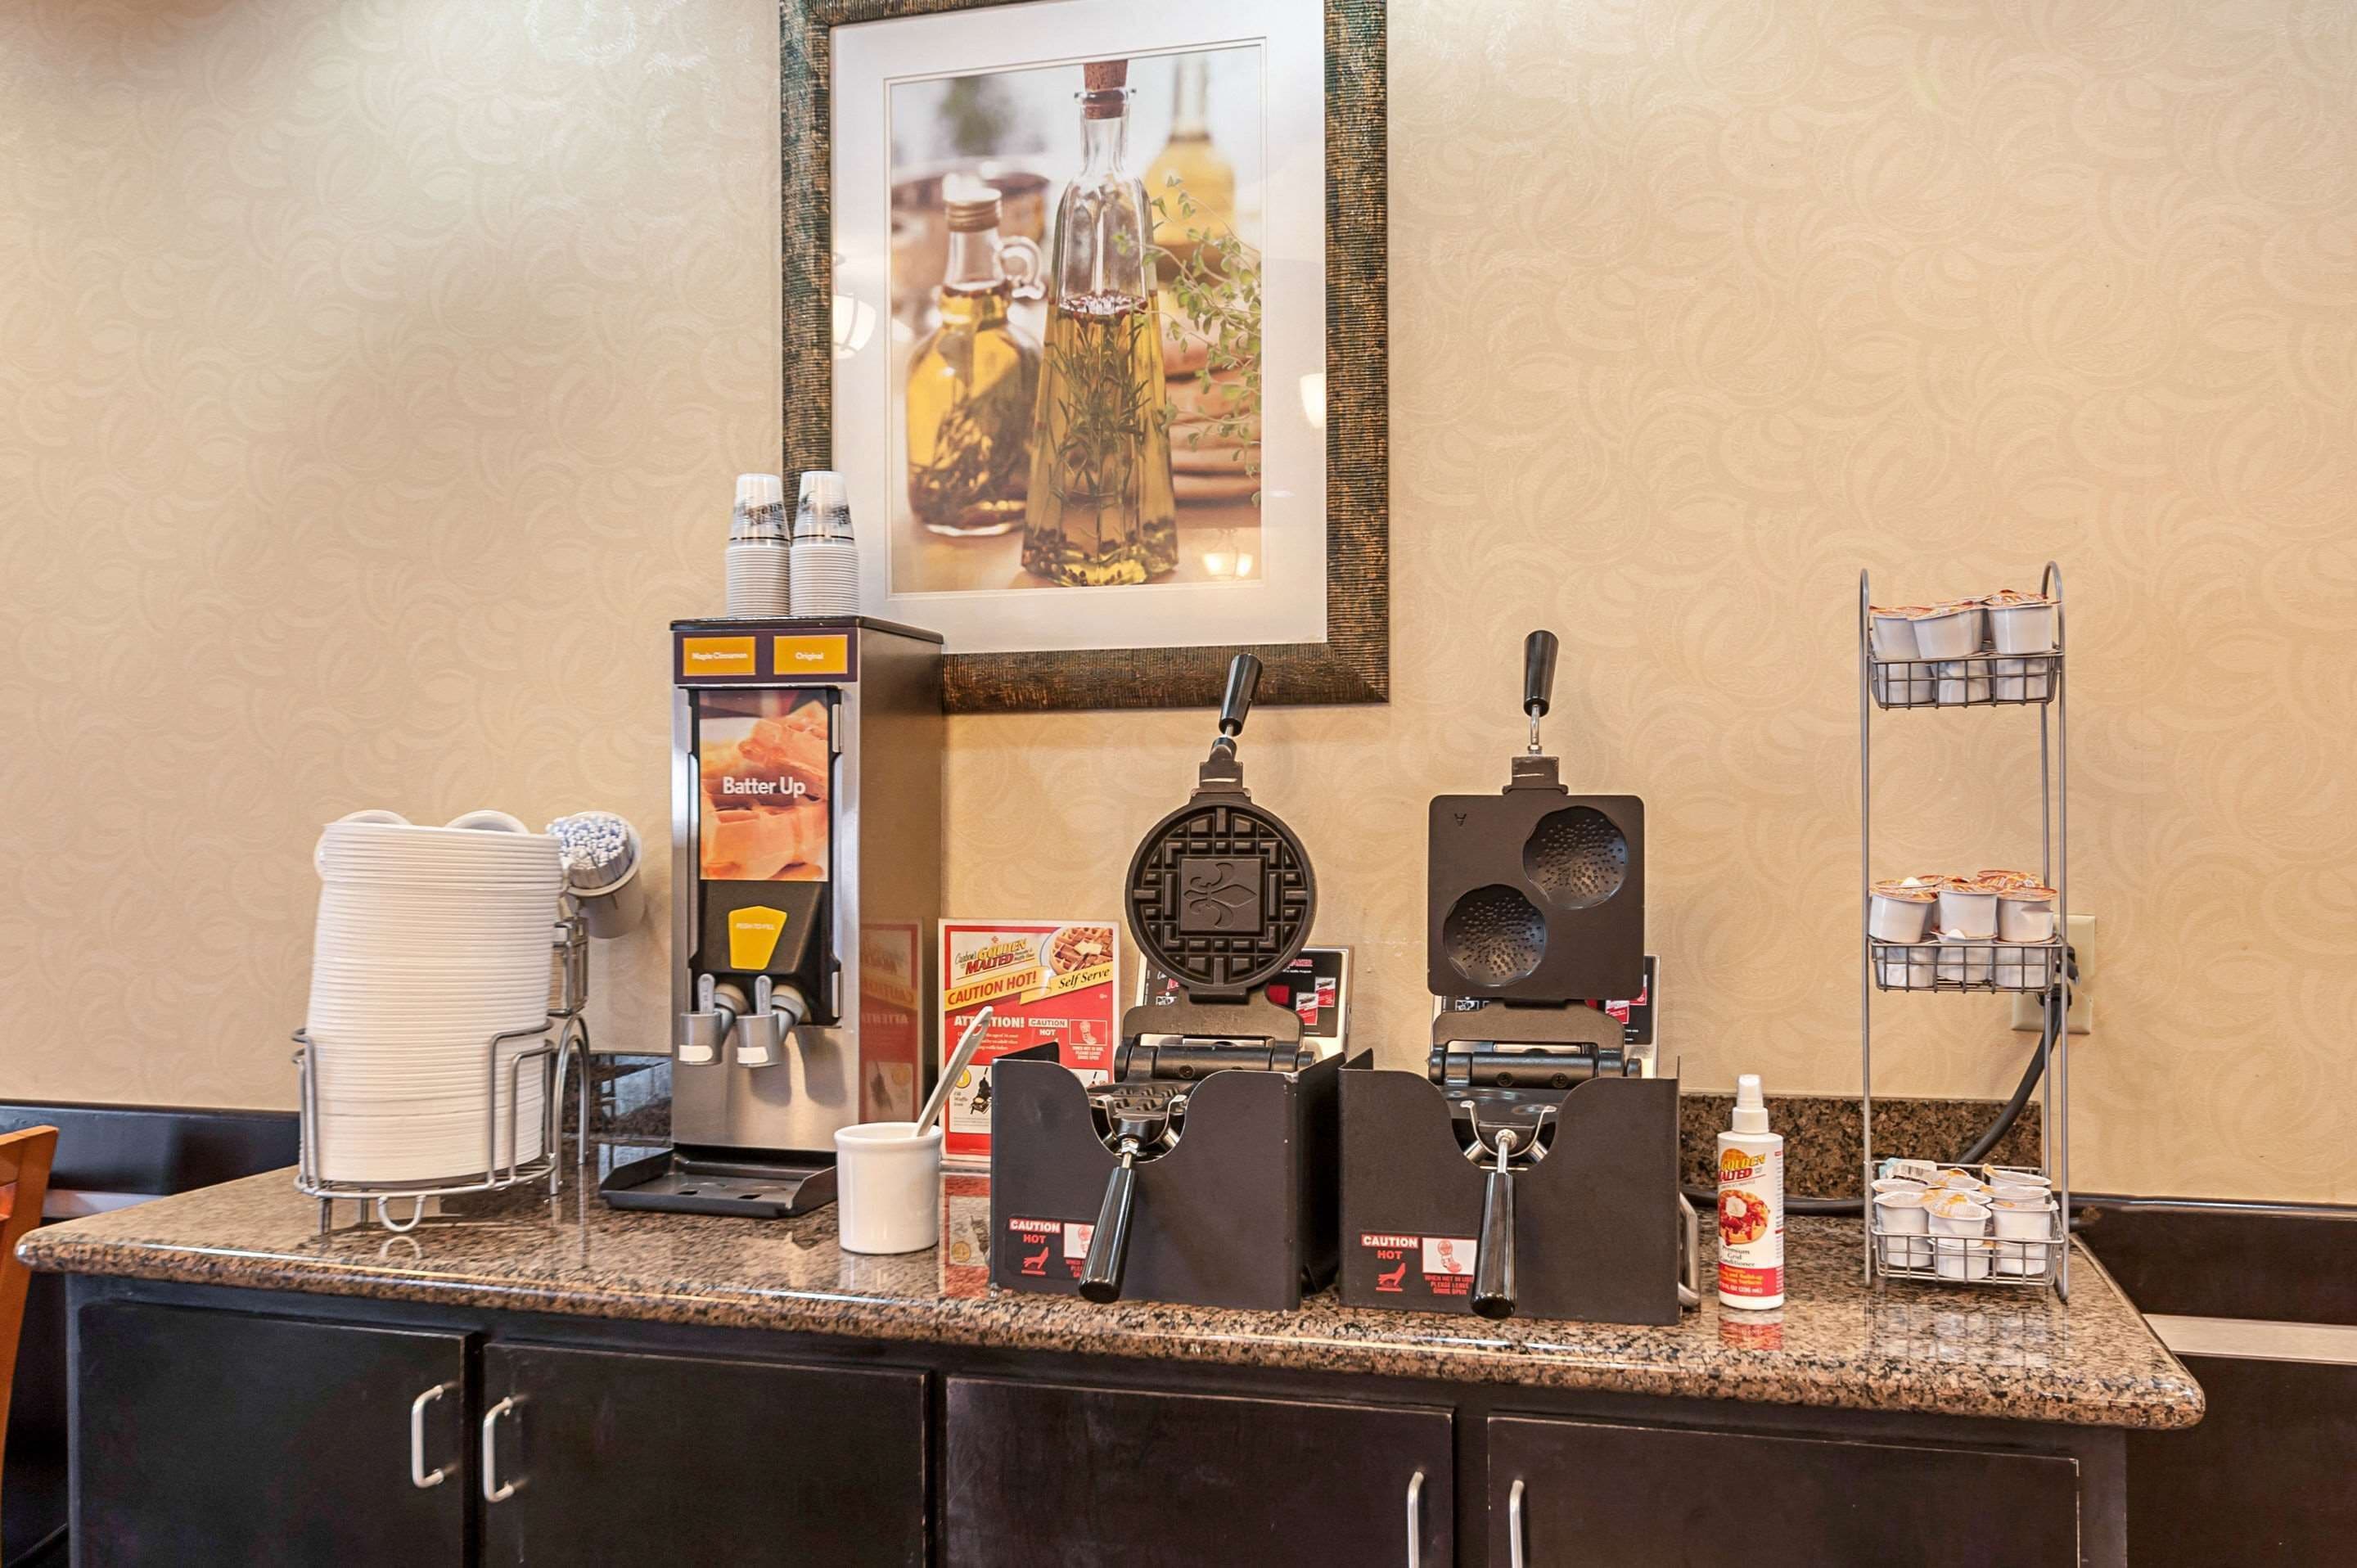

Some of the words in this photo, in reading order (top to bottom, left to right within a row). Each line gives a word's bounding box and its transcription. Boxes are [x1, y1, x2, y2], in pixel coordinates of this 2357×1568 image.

[795, 651, 824, 661] Original
[723, 776, 776, 795] Batter
[779, 777, 806, 798] Up
[965, 953, 1014, 975] MALTED
[1058, 975, 1078, 989] Self
[1081, 968, 1110, 983] Serve
[948, 980, 1006, 1006] CAUTION
[1006, 971, 1037, 991] HOT!
[953, 1015, 1025, 1028] ATTTION!
[1030, 1019, 1066, 1027] CAUTION
[1721, 1152, 1765, 1171] GOLDEN
[1010, 1219, 1061, 1232] CAUTION
[1023, 1234, 1047, 1244] HOT
[1362, 1235, 1418, 1247] CAUTION
[1377, 1250, 1403, 1259] HOT
[1722, 1245, 1750, 1255] Premium
